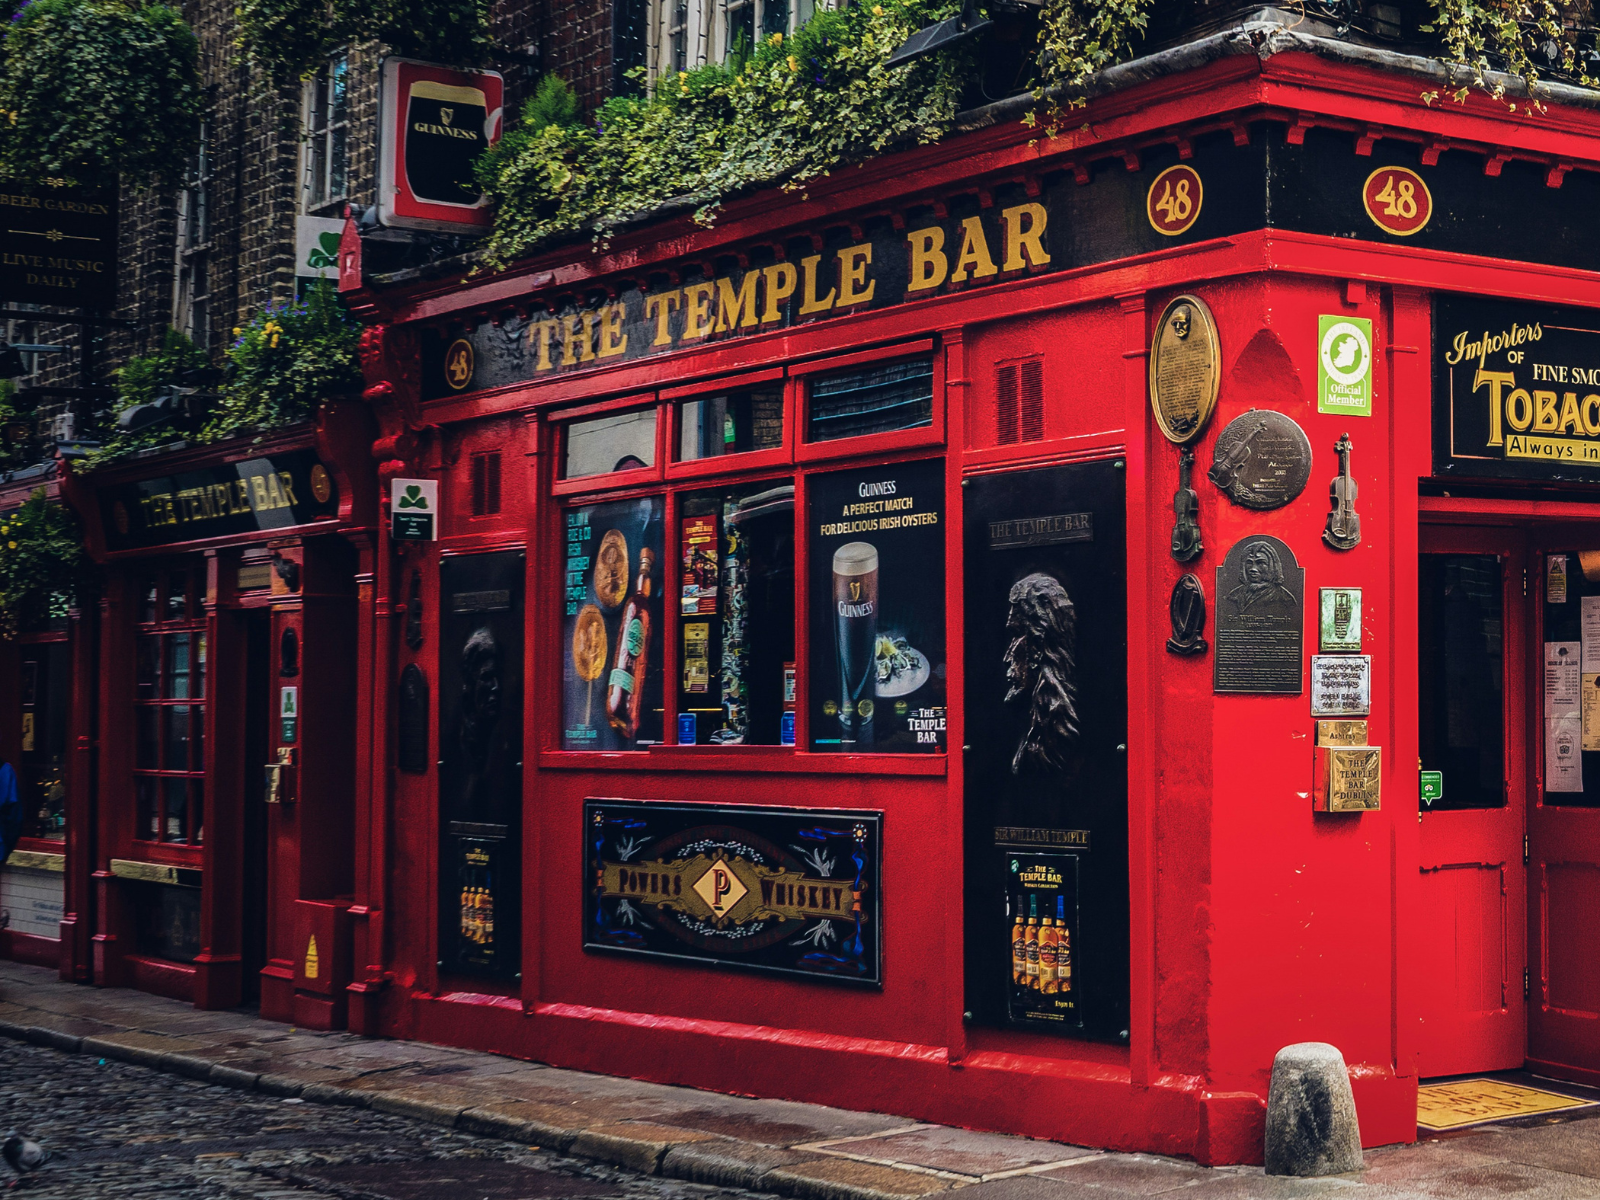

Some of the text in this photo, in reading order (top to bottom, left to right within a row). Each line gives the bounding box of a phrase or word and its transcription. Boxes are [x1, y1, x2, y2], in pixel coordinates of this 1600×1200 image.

[414, 122, 478, 140] GUINNESS
[0, 194, 109, 215] BEER GARDEN
[1157, 177, 1194, 224] 48
[1375, 175, 1418, 220] 48
[3, 253, 104, 273] LIVE MUSIC
[27, 273, 80, 288] DAILY
[529, 203, 1052, 373] THE TEMPLE BAR
[1445, 322, 1543, 369] Importers
[450, 350, 468, 381] 48
[1507, 351, 1525, 365] OF
[1532, 363, 1569, 384] FINE
[1330, 384, 1362, 395] Official
[1327, 394, 1364, 405] Member
[1509, 436, 1574, 459] Always
[1583, 443, 1598, 459] in
[177, 478, 251, 522] TEMPLE
[251, 471, 298, 511] BAR
[859, 480, 897, 497] GUINNESS
[842, 497, 913, 517] A PERFECT MATCH
[820, 512, 938, 536] FOR DELICIOUS IRISH OYSTERS
[990, 514, 1090, 538] THE TEMPLE BAR
[838, 601, 874, 618] GUINNESS
[919, 708, 935, 718] THE
[907, 718, 946, 731] TEMPLE
[917, 731, 937, 743] BAR
[1329, 732, 1356, 741] Ashtray
[1348, 759, 1365, 767] THE
[1340, 770, 1372, 778] TEMPLE
[1348, 781, 1364, 789] BAR
[1340, 791, 1373, 800] DUBLIN
[1010, 829, 1050, 842] WILLIAM
[1051, 829, 1088, 844] TEMPLE
[619, 868, 682, 897] POWERS
[1019, 872, 1063, 883] TEMPLE BAR
[712, 869, 731, 911] P
[760, 879, 843, 911] WHISKEY
